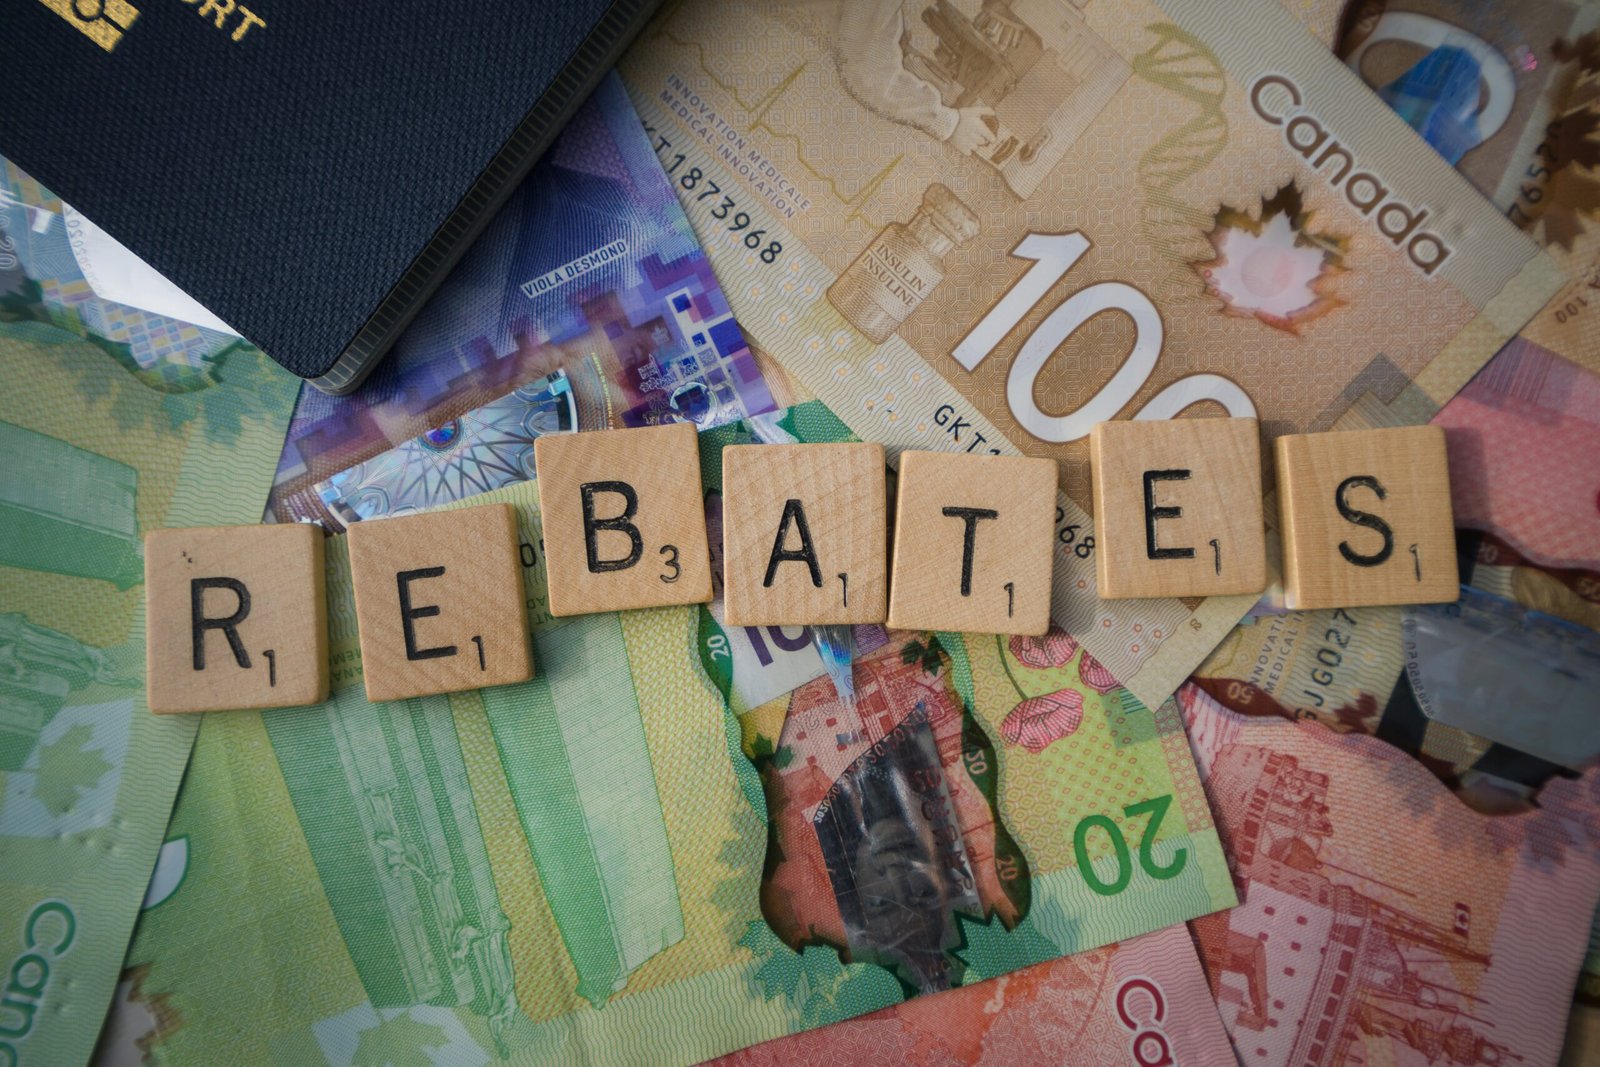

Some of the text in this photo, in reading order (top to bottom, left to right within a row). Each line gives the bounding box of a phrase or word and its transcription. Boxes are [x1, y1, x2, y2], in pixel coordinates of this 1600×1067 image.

[659, 90, 795, 218] MEDICAL INNOVATION
[667, 74, 810, 211] INNOVATION MÉDICALE
[1250, 74, 1452, 276] Canada
[523, 240, 628, 297] VIOLA DESMOND
[860, 253, 917, 310] INSULINE
[873, 242, 928, 293] INSULIN
[1554, 295, 1588, 325] 100
[933, 403, 1001, 456] GKT
[658, 544, 682, 585] 3
[1208, 538, 1223, 577] 1
[1407, 542, 1423, 583] 1
[837, 572, 849, 608] 1
[1002, 581, 1015, 619] 1
[261, 648, 278, 688] 1
[470, 635, 487, 672] 1
[706, 633, 730, 662] 20
[1263, 628, 1299, 695] MEDICAL
[1072, 793, 1189, 898] 20
[0, 901, 77, 1067] Can
